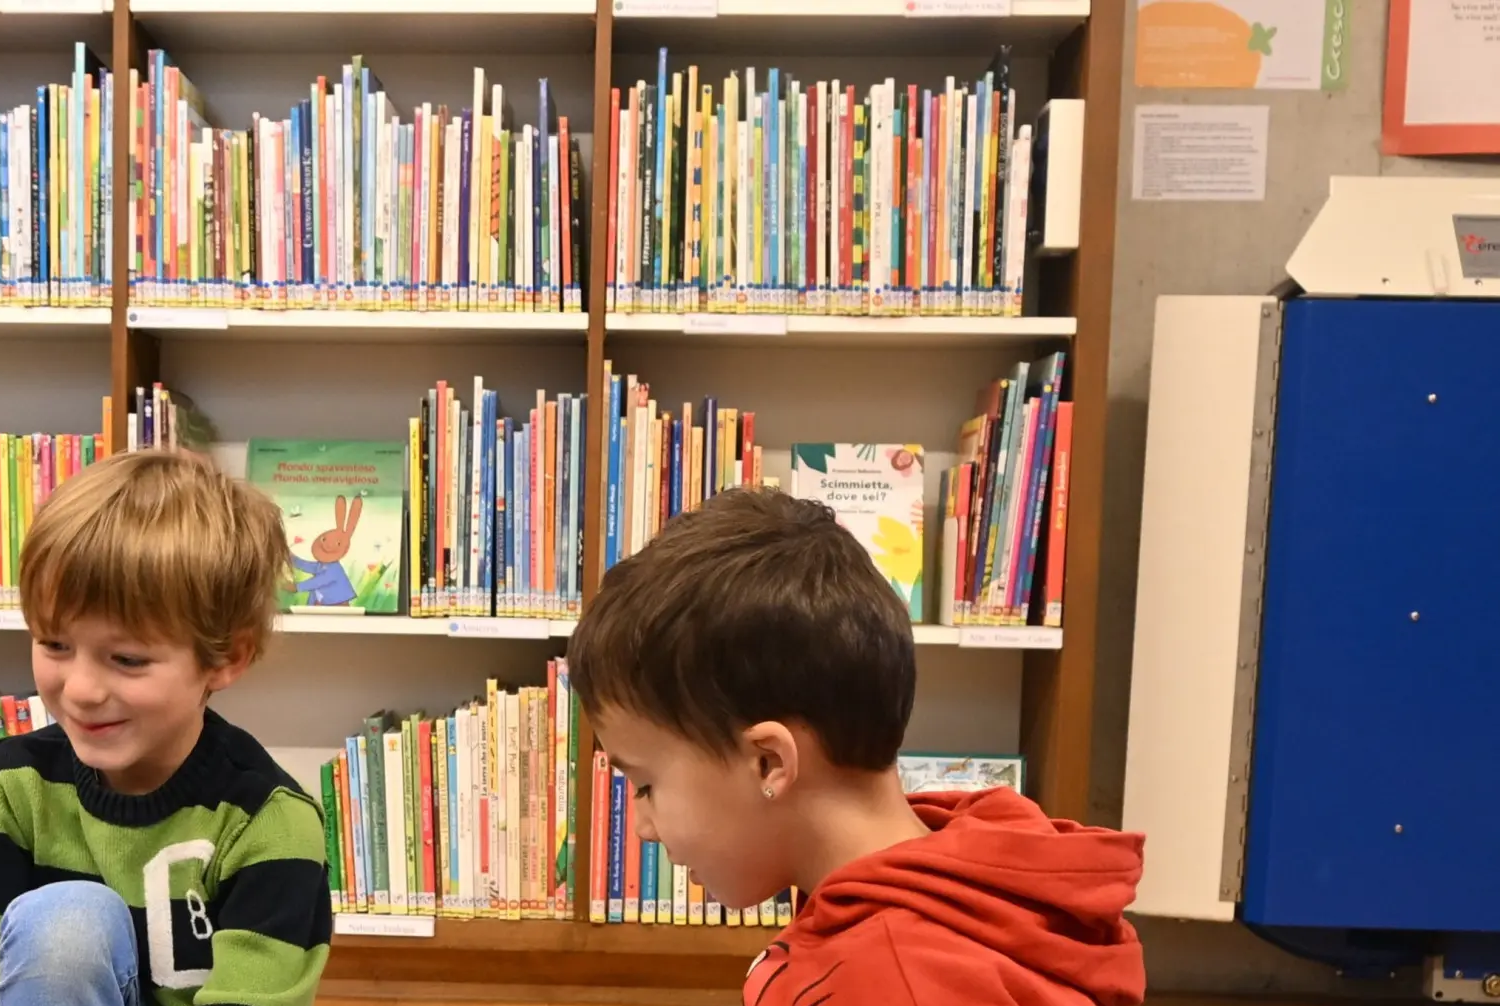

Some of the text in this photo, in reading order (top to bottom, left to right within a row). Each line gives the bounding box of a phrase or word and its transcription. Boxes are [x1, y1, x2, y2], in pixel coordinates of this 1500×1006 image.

[277, 462, 376, 474] Mondo spaventoso
[274, 474, 379, 486] Mondo meraviglioso
[820, 479, 893, 490] Scimmietta,
[826, 491, 858, 501] dove
